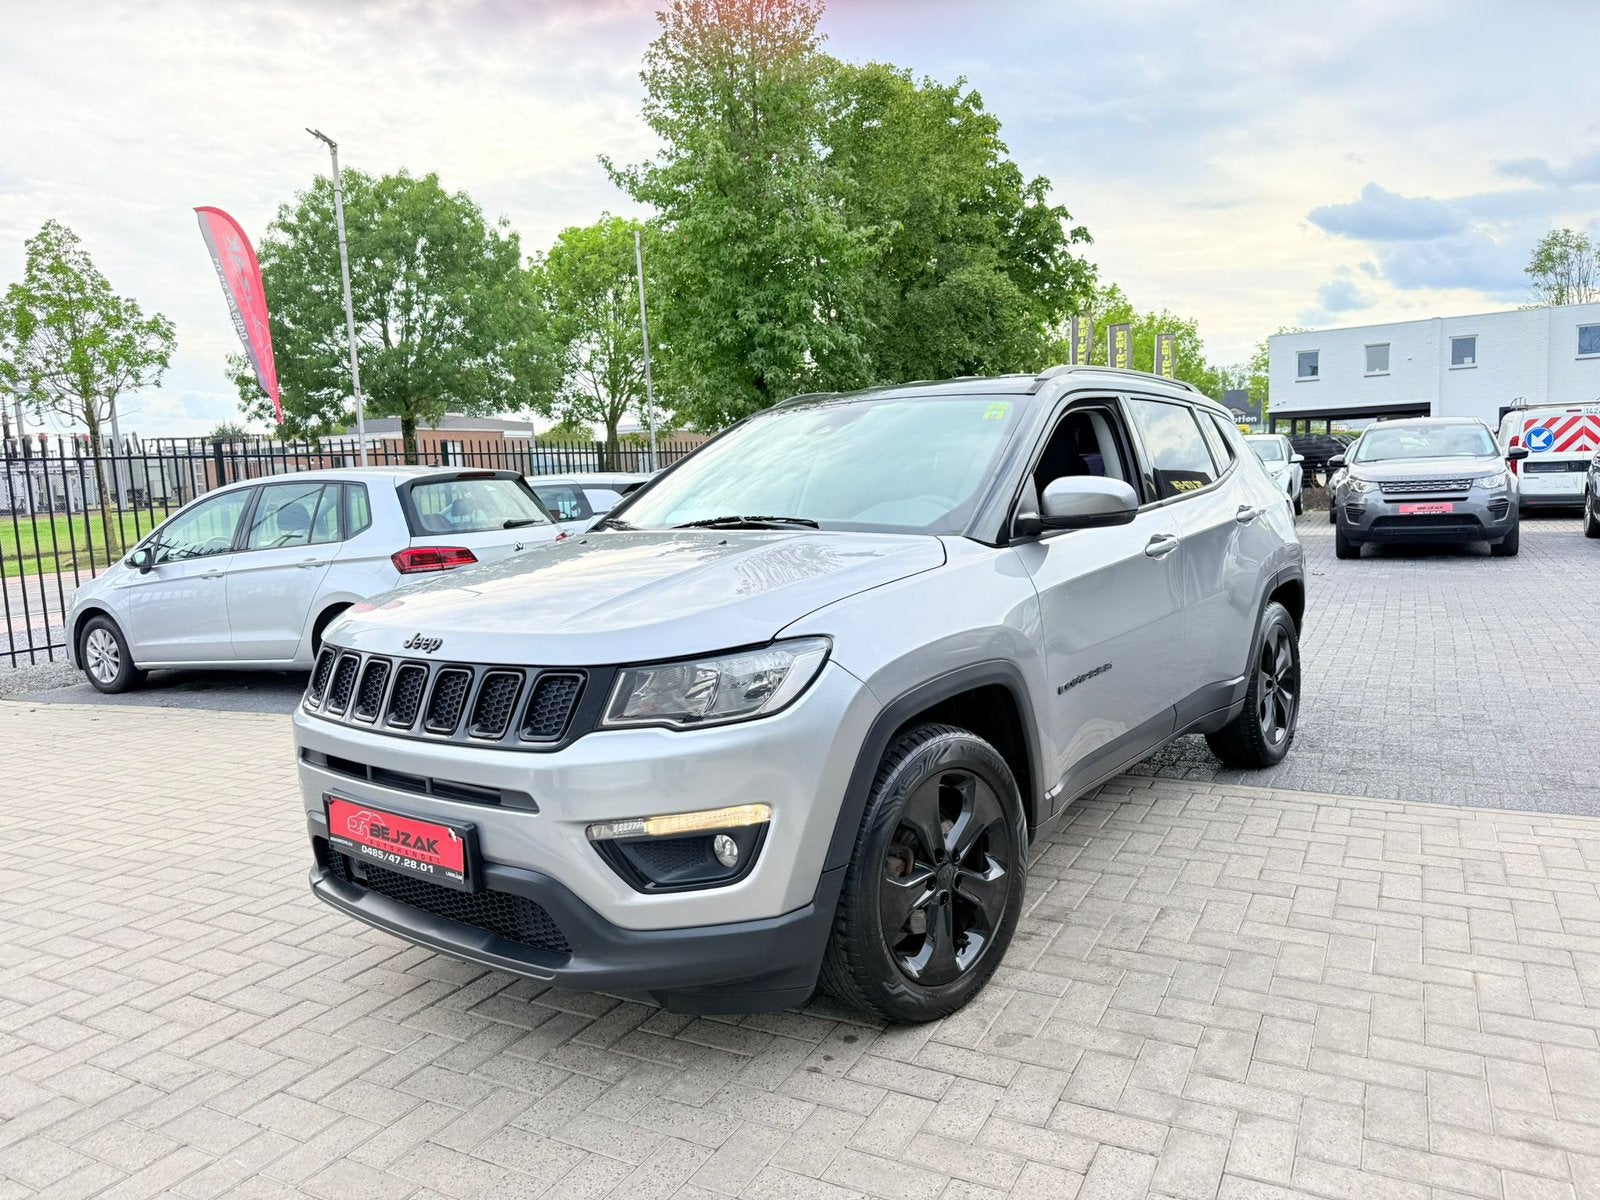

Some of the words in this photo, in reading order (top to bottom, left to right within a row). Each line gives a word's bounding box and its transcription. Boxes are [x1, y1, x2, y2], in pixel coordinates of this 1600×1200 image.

[403, 632, 443, 654] Jeep
[369, 822, 440, 854] BEJZAK
[361, 845, 434, 873] 0485/47.28.01
